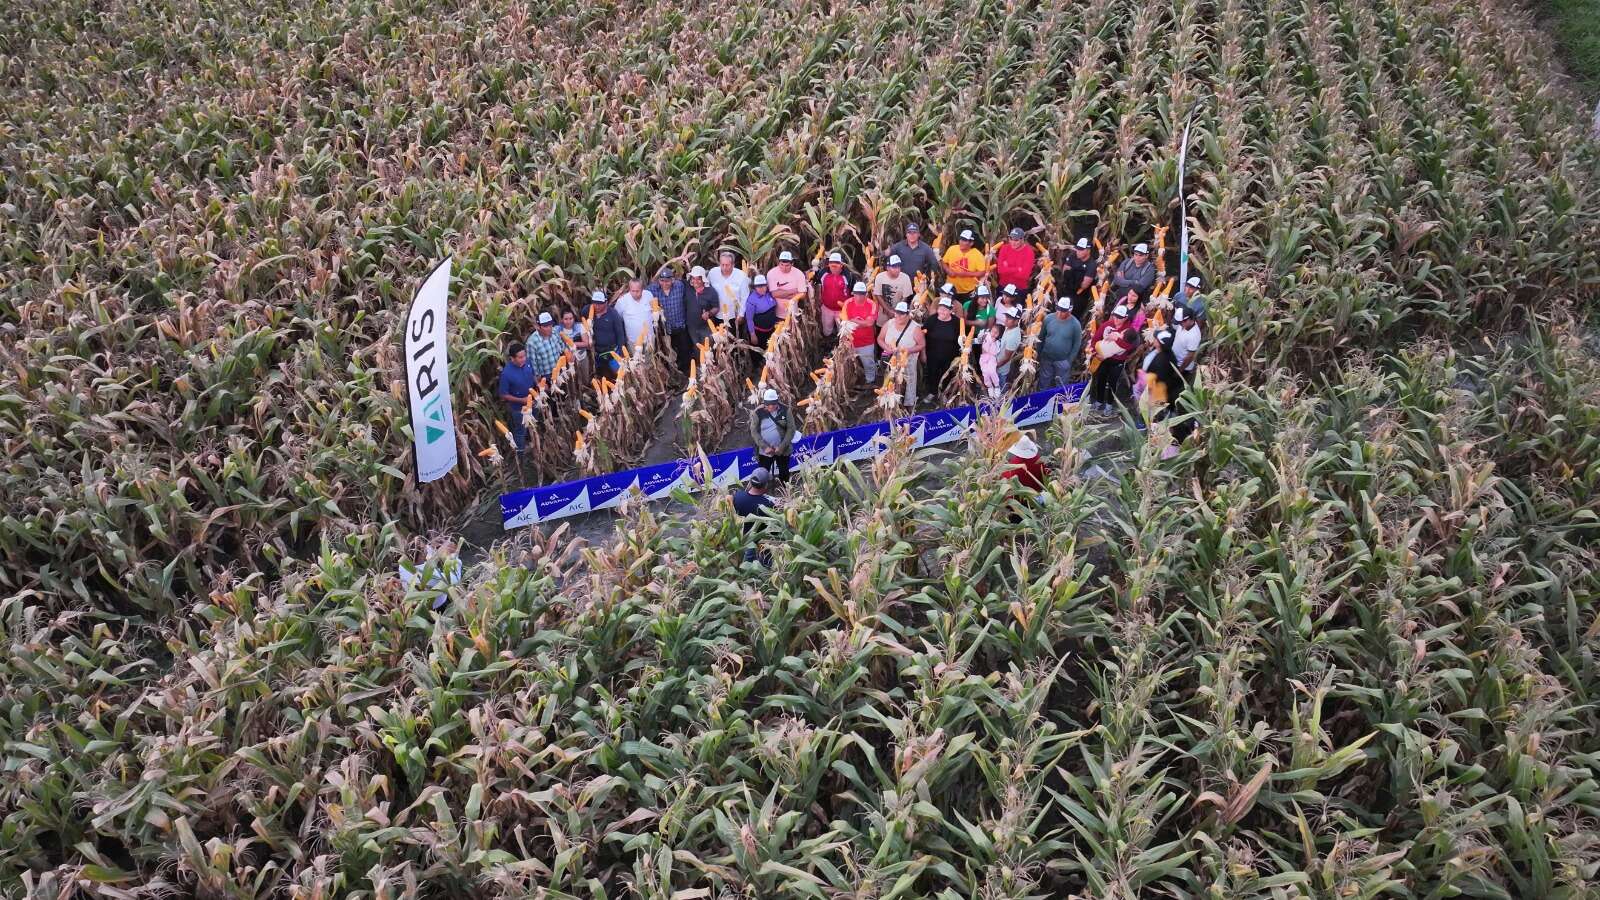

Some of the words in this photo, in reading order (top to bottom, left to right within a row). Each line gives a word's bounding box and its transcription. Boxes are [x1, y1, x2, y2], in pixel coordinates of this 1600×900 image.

[928, 423, 953, 431] ADVANTA
[838, 440, 863, 448] ADVANTA
[592, 487, 621, 496] ADVANTA
[540, 497, 570, 507] ADVANTA
